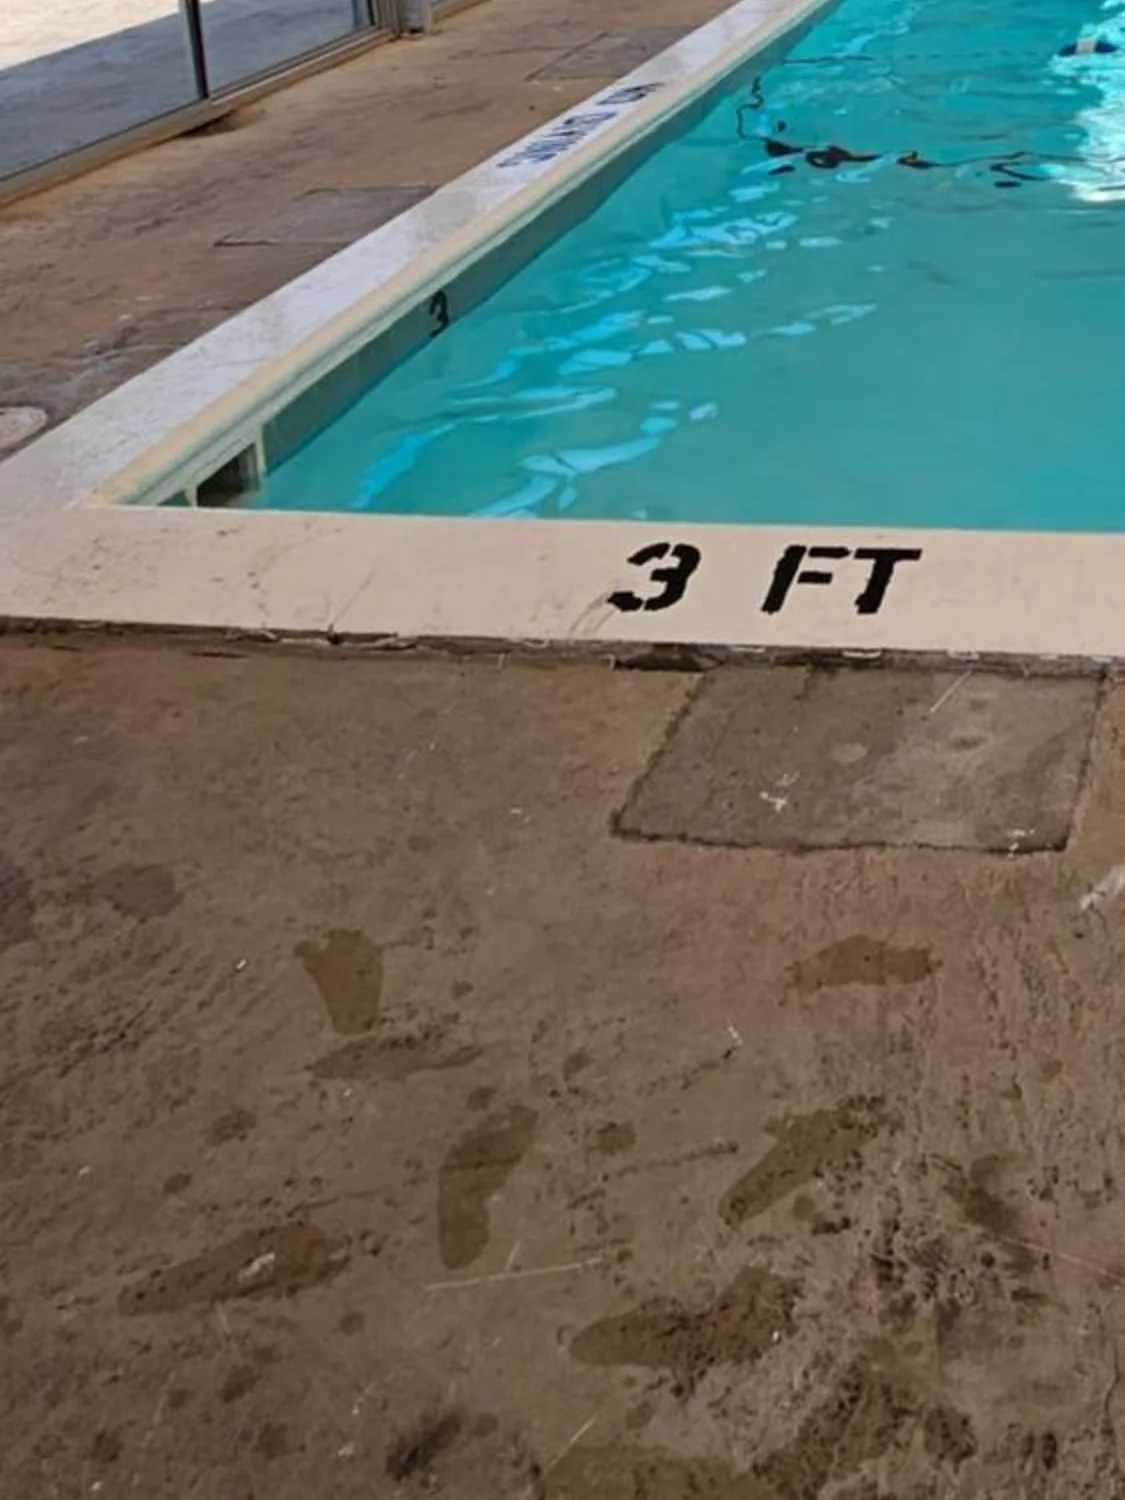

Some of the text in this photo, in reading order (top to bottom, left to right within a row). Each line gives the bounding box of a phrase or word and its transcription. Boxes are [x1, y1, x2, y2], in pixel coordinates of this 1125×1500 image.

[428, 288, 449, 339] 3
[607, 542, 922, 615] 3 FT
